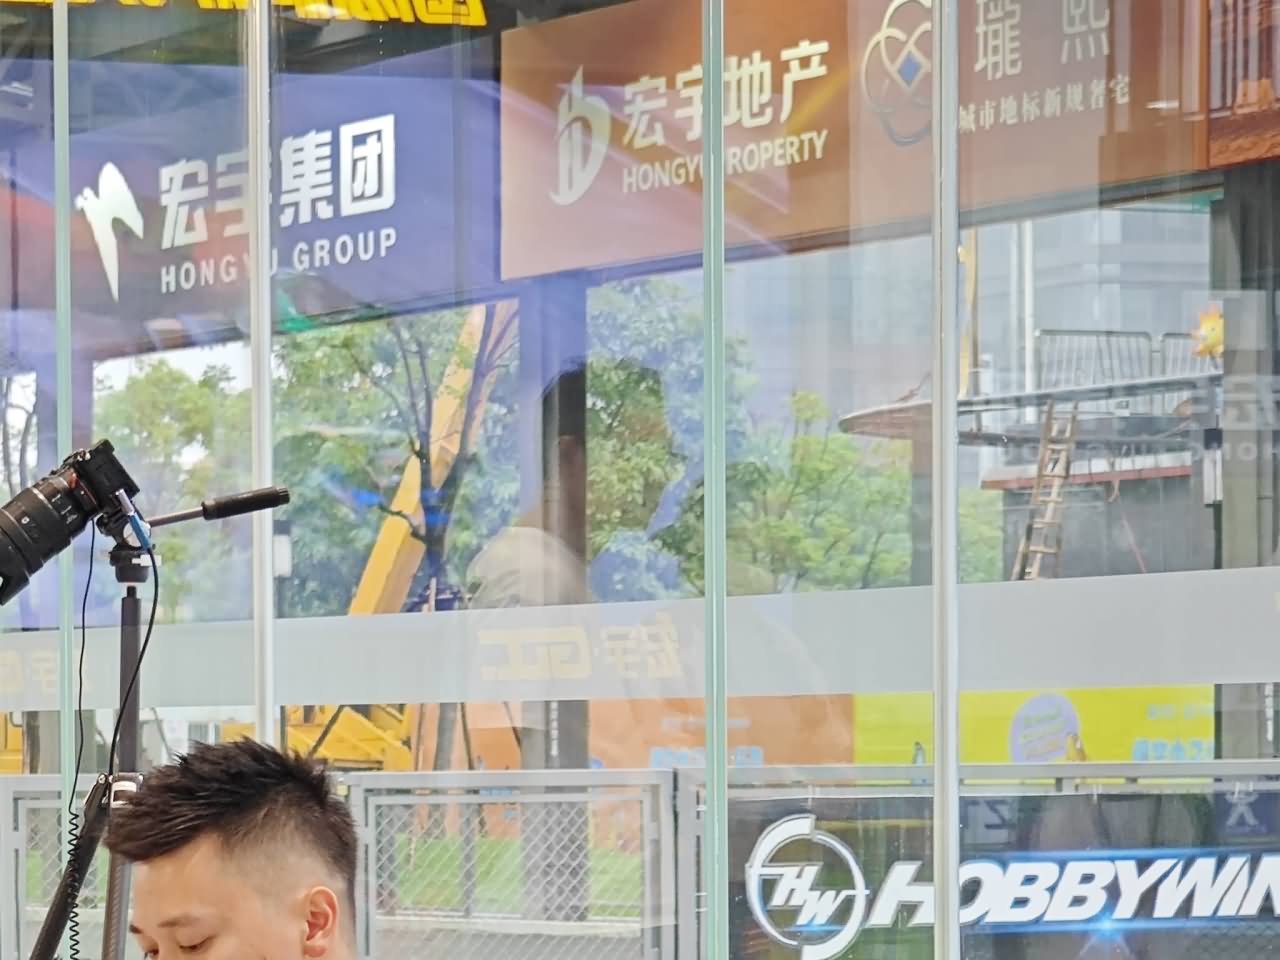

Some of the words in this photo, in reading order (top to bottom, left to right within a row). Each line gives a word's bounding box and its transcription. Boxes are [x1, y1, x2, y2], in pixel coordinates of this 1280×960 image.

[622, 39, 830, 150] 宏宇地产
[159, 113, 396, 249] 宏宇集团
[724, 128, 828, 175] ROPERTY
[293, 227, 397, 271] GROUP
